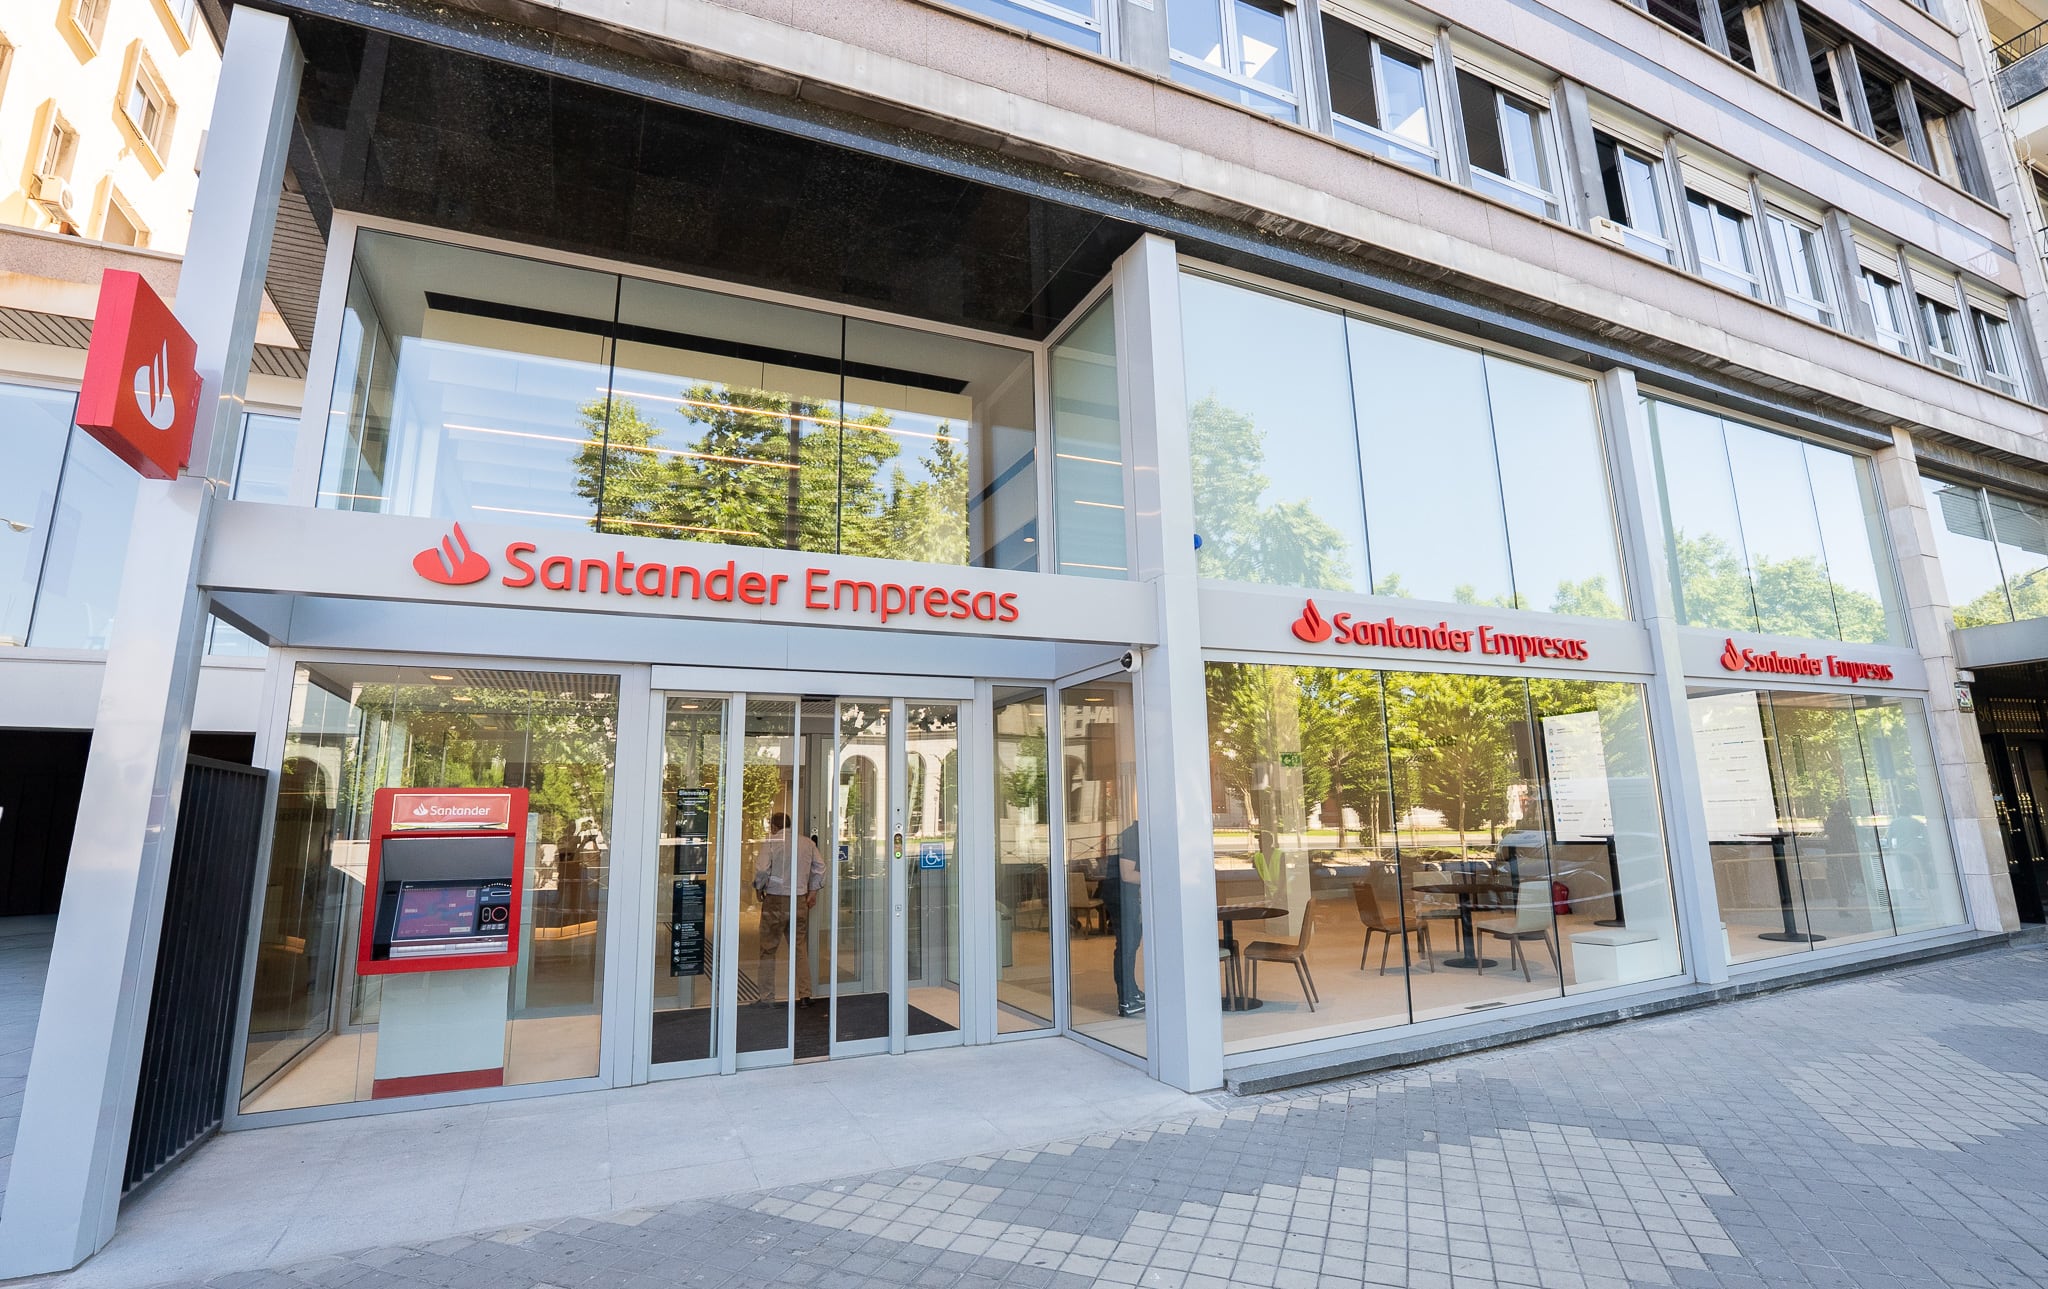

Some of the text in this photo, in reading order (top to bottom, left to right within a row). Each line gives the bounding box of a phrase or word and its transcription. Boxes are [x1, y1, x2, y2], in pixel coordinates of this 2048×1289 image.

[502, 541, 1020, 624] Santander Empresas
[1334, 612, 1590, 663] Santander Empresas
[1742, 648, 1894, 684] Santander Empresas
[430, 805, 491, 816] Santander
